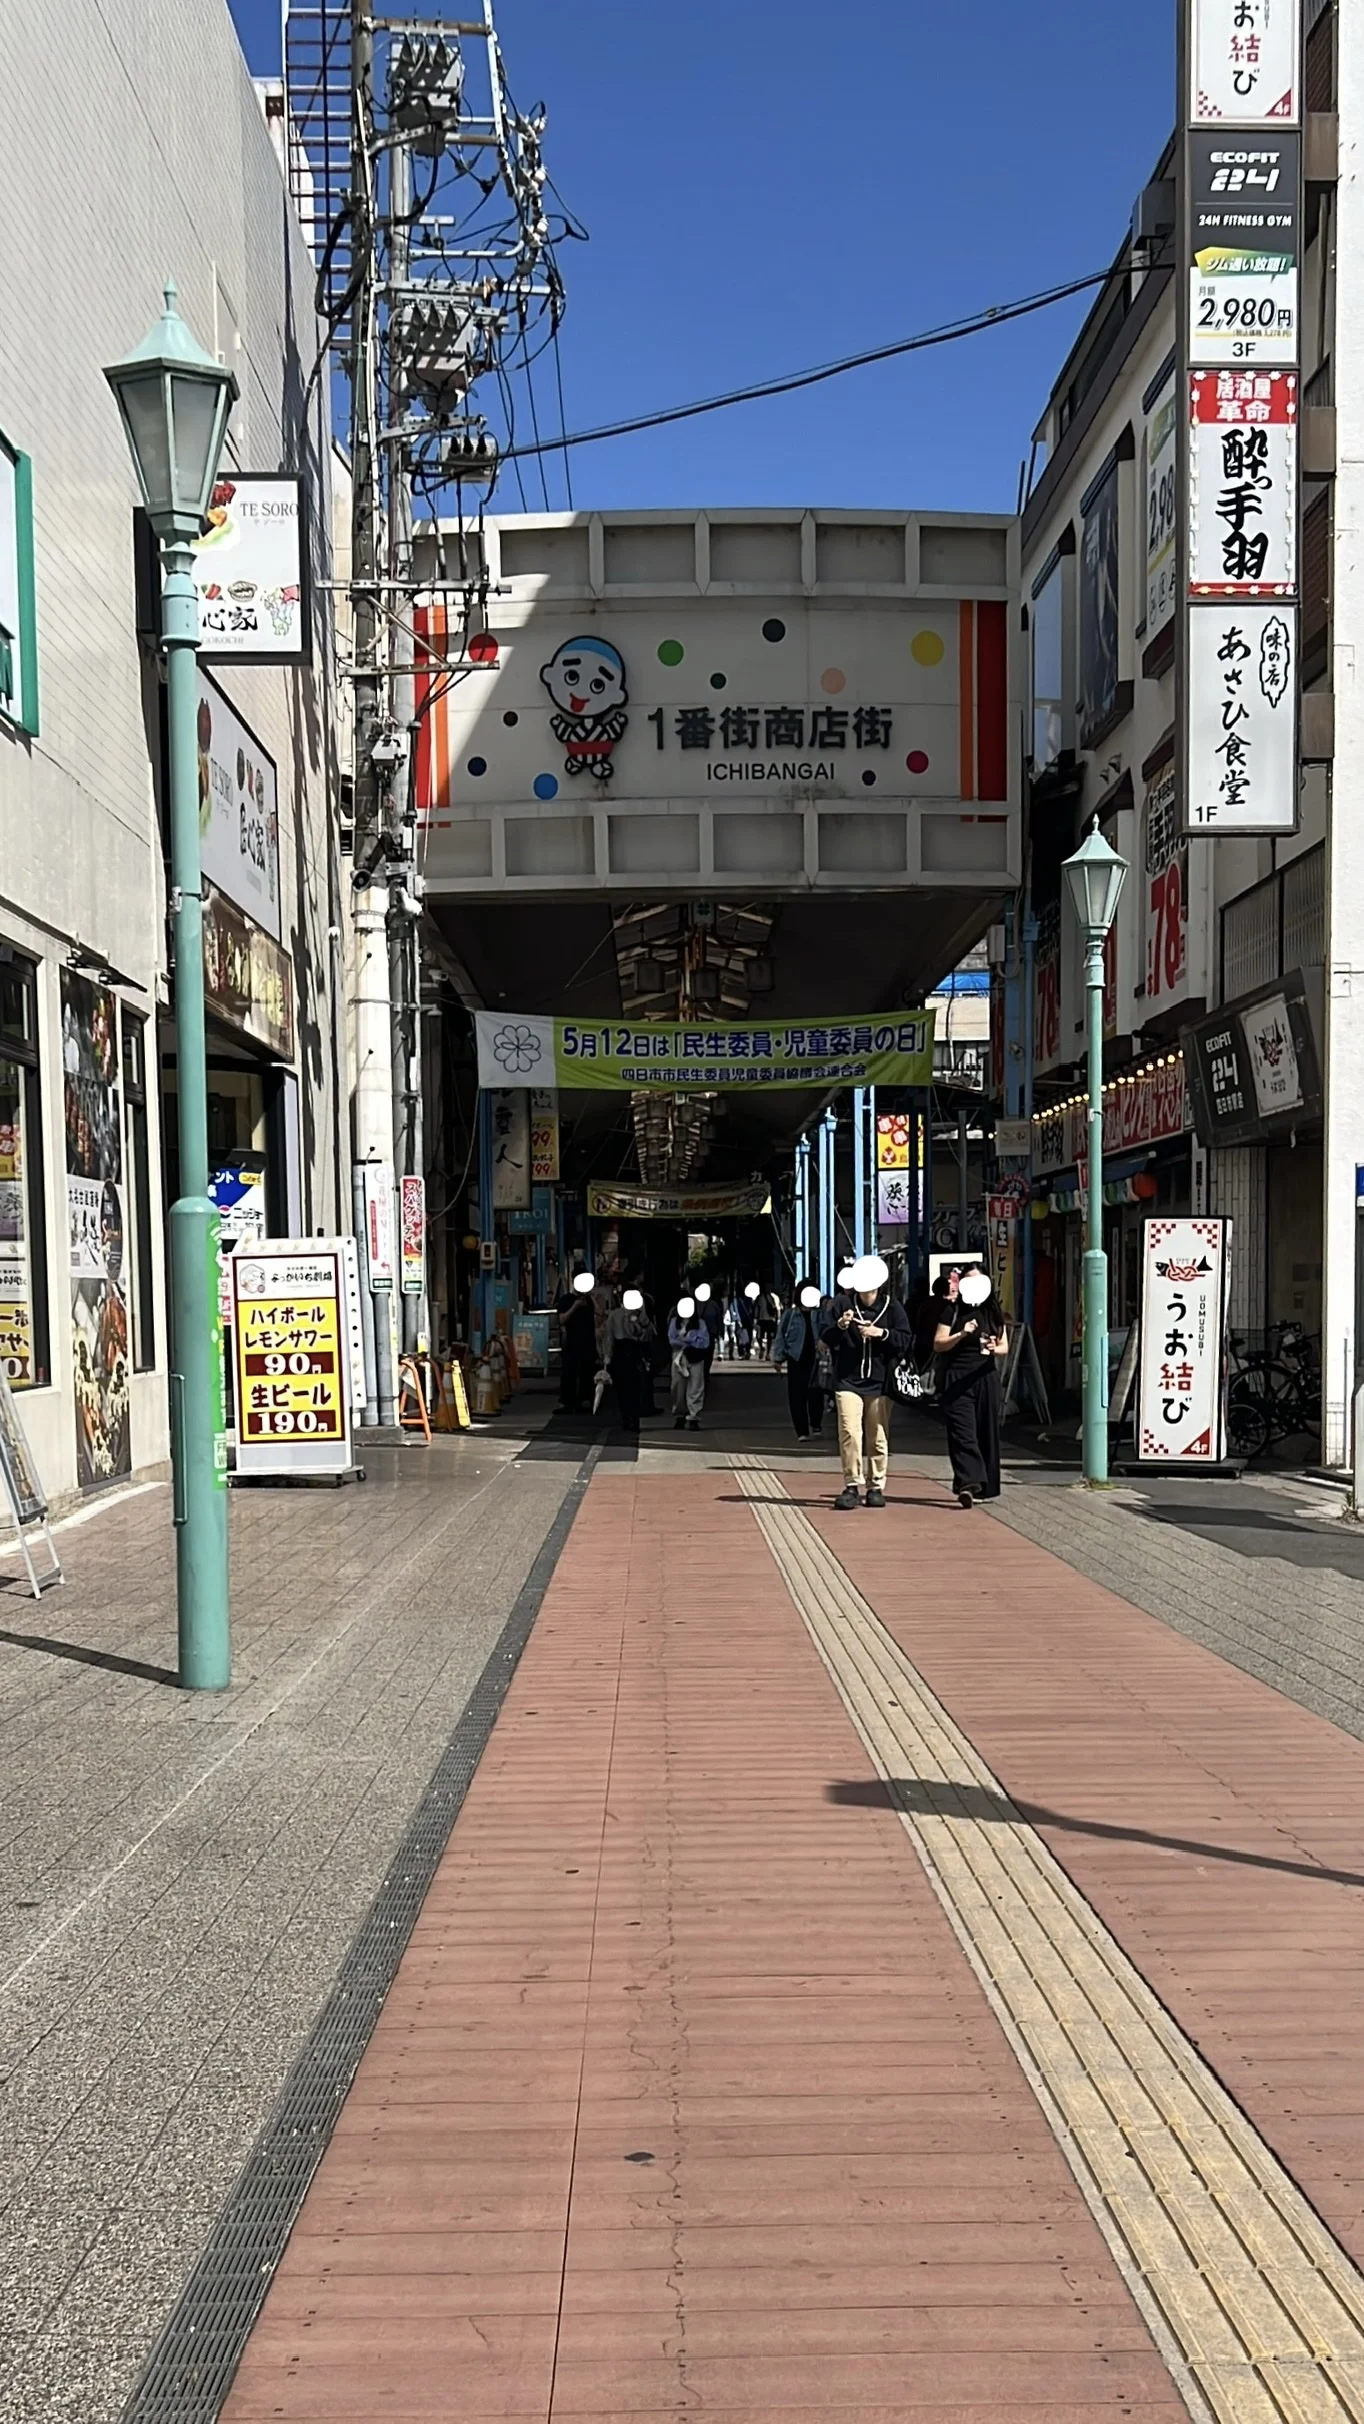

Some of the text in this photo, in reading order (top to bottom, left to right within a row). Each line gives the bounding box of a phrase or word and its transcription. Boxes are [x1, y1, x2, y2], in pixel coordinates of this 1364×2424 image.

[1227, 0, 1261, 96] お結び
[1273, 101, 1290, 116] 4F
[1209, 151, 1280, 164] ECOFIT
[1209, 167, 1280, 192] 24
[1198, 214, 1292, 227] 24H FITNESS GYM
[1198, 286, 1216, 297] 月額
[1197, 297, 1294, 330] 2,980円
[1232, 342, 1256, 357] 3F
[1216, 377, 1272, 399] 居酒屋
[1216, 400, 1271, 422] 革命
[1264, 628, 1283, 687] 味の店
[1215, 626, 1252, 805] あさひ食堂
[648, 705, 893, 751] 1番街商店街
[706, 762, 835, 781] ICHIBANGAI
[1195, 806, 1218, 823] 1F
[1211, 1052, 1239, 1093] 24
[250, 1306, 326, 1325] ハイボール
[245, 1329, 333, 1349] レモンサワー
[264, 1353, 322, 1375] 90円
[1158, 1292, 1194, 1425] うお結び
[251, 1383, 332, 1409] 生ビール
[258, 1411, 328, 1434] 190円
[1191, 1440, 1208, 1453] 4F
